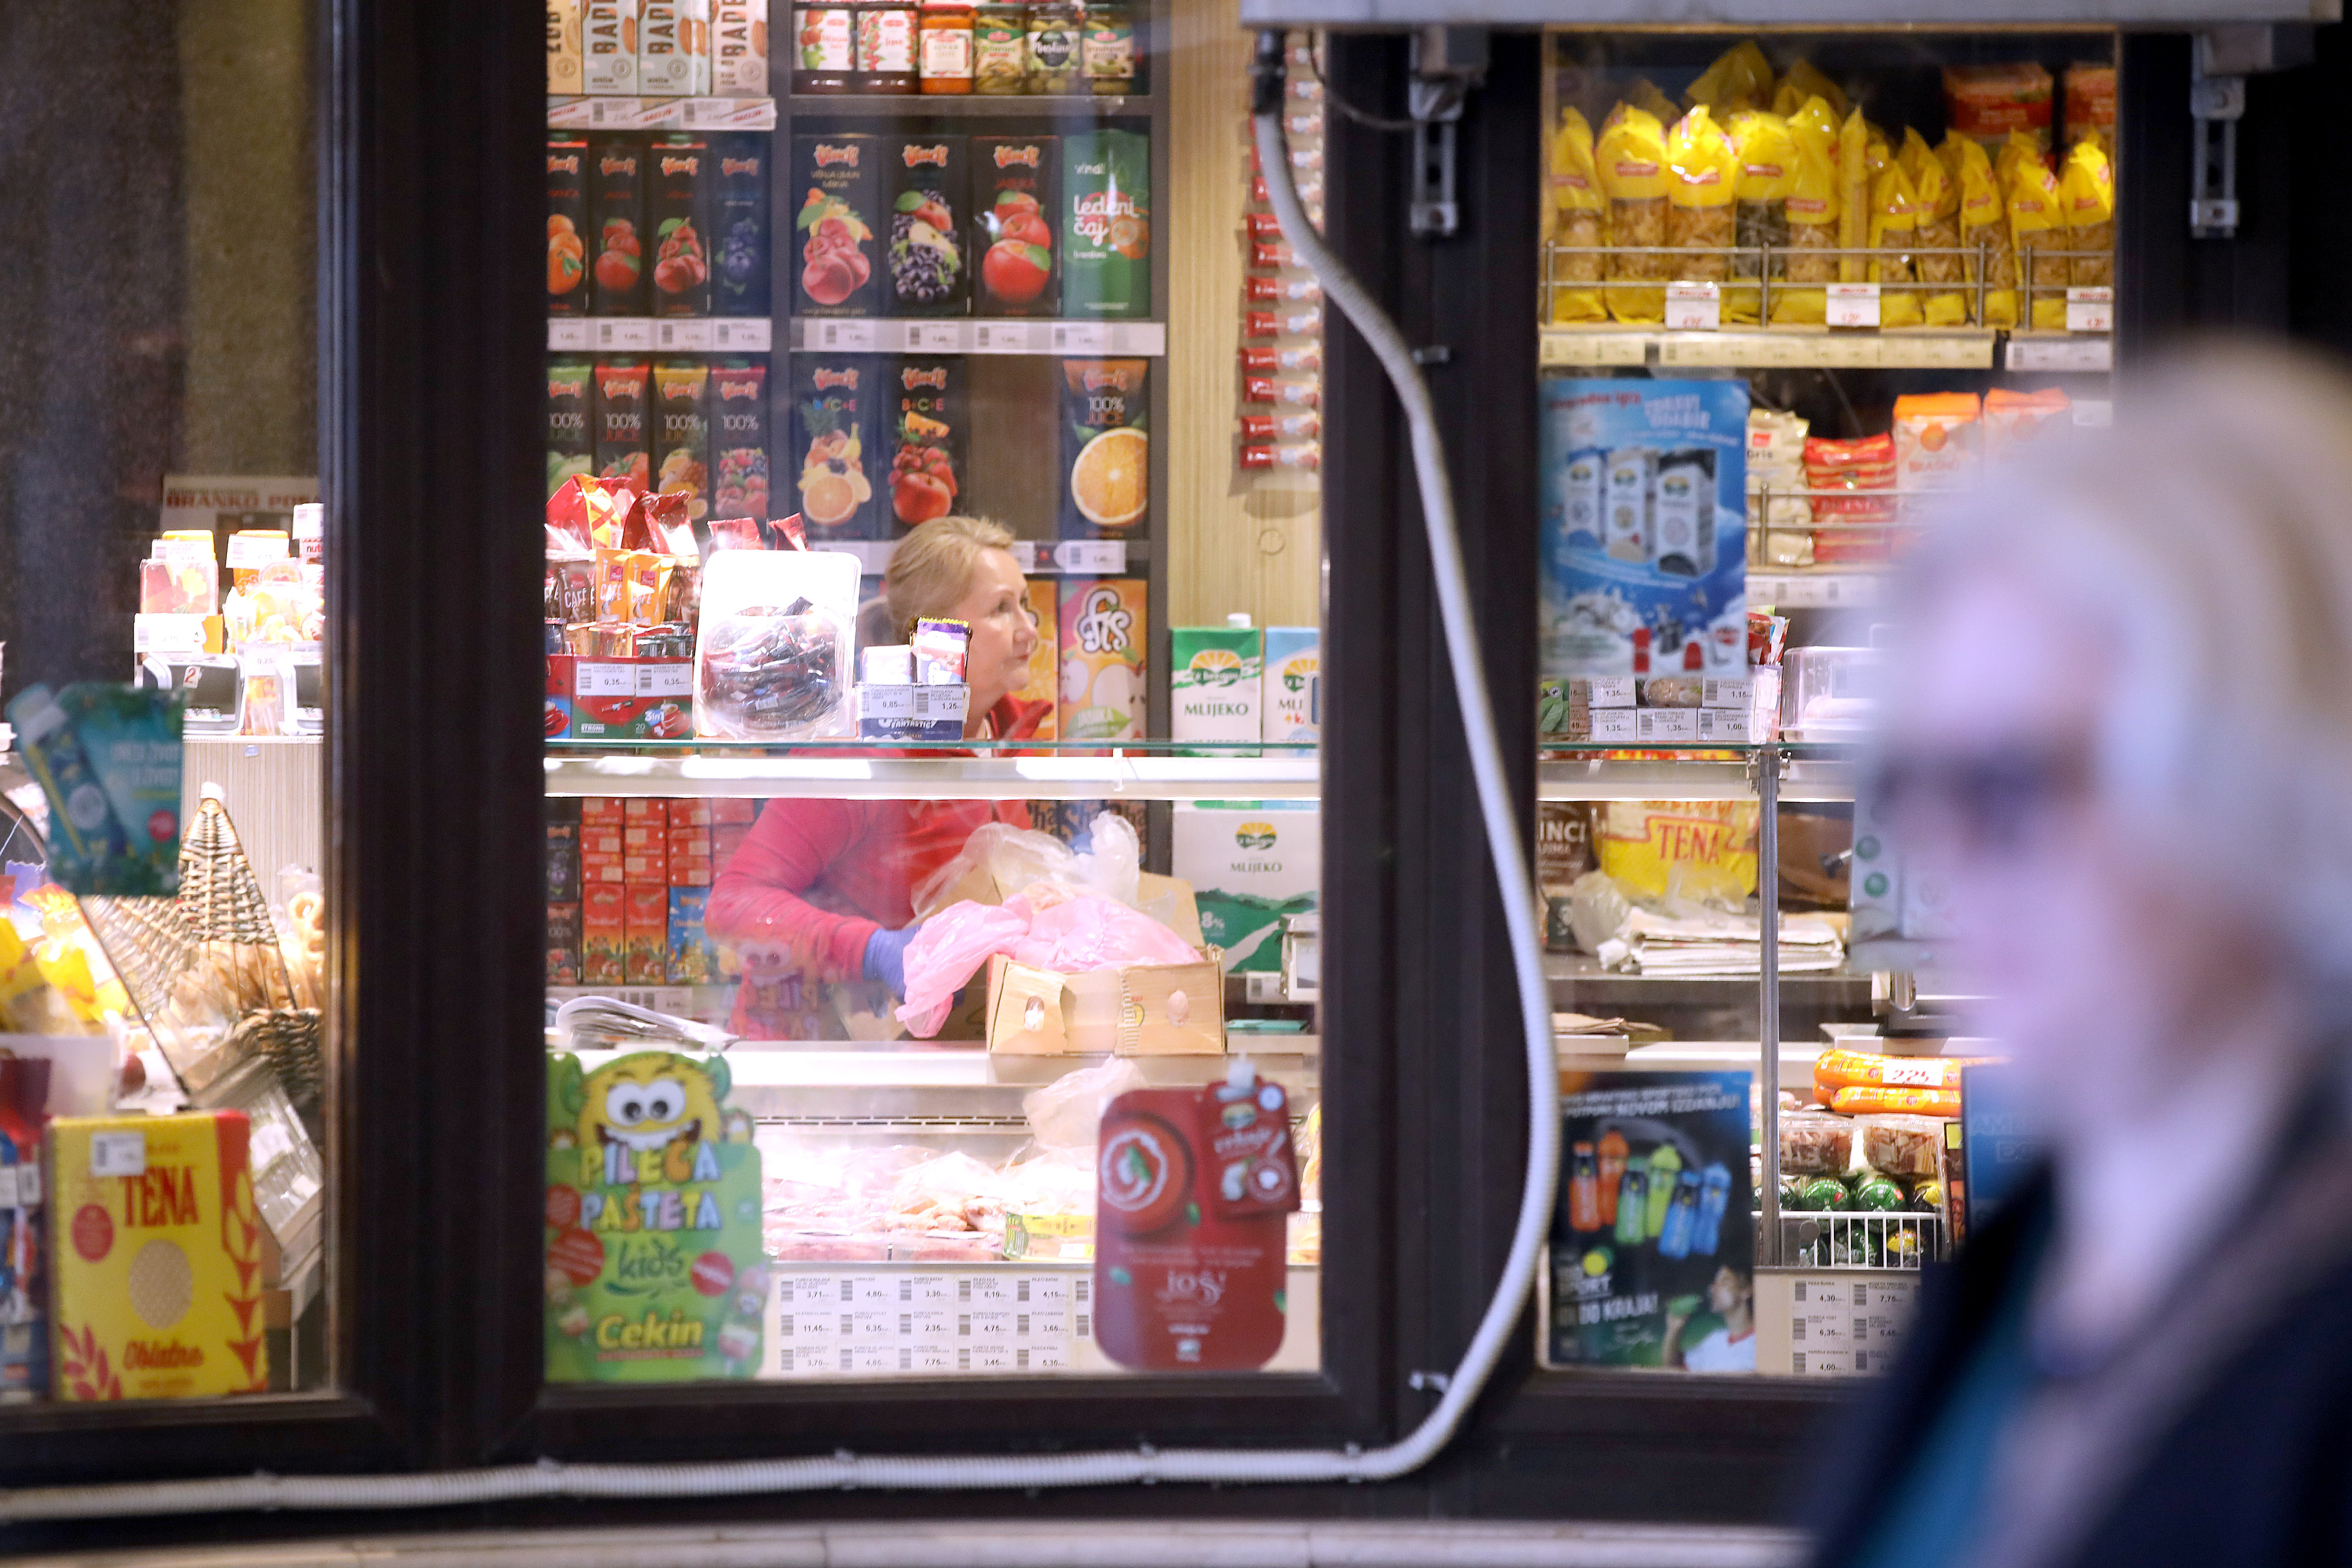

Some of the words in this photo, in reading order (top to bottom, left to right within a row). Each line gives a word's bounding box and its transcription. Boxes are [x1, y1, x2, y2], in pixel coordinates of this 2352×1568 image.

[1089, 396, 1124, 412] 100%
[606, 413, 642, 430] 100%
[665, 413, 700, 431] 100%
[722, 414, 760, 431] 100%
[184, 668, 197, 684] 2
[1184, 703, 1249, 718] MLIJEKO
[1658, 823, 1720, 866] TENA
[1230, 862, 1282, 873] MLIJEKO
[118, 1165, 201, 1228] TENA
[619, 1238, 687, 1282] kids
